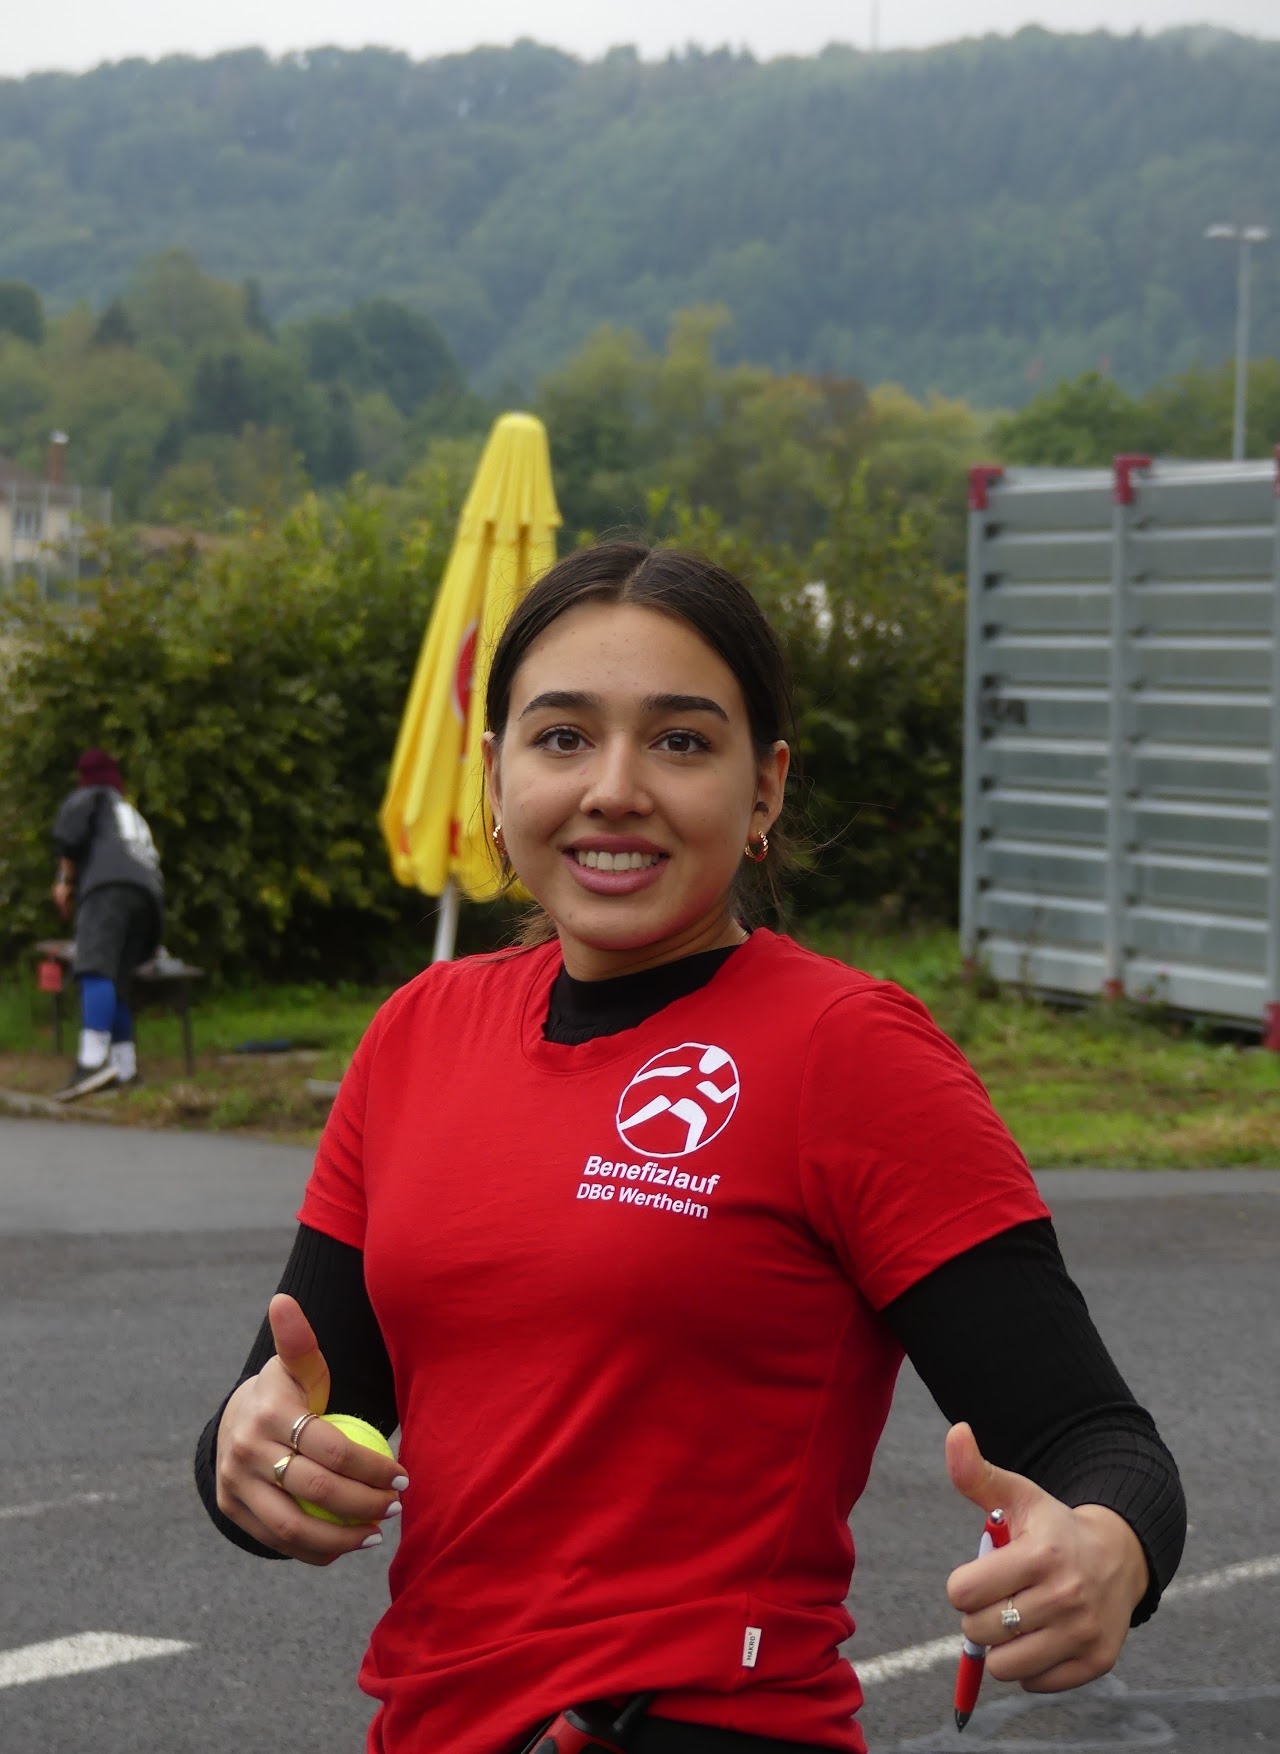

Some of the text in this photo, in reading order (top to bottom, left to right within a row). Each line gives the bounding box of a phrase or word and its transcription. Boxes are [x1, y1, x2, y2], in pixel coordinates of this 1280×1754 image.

[583, 1155, 720, 1195] Benefizlauf
[576, 1183, 709, 1219] DBG Wertheim
